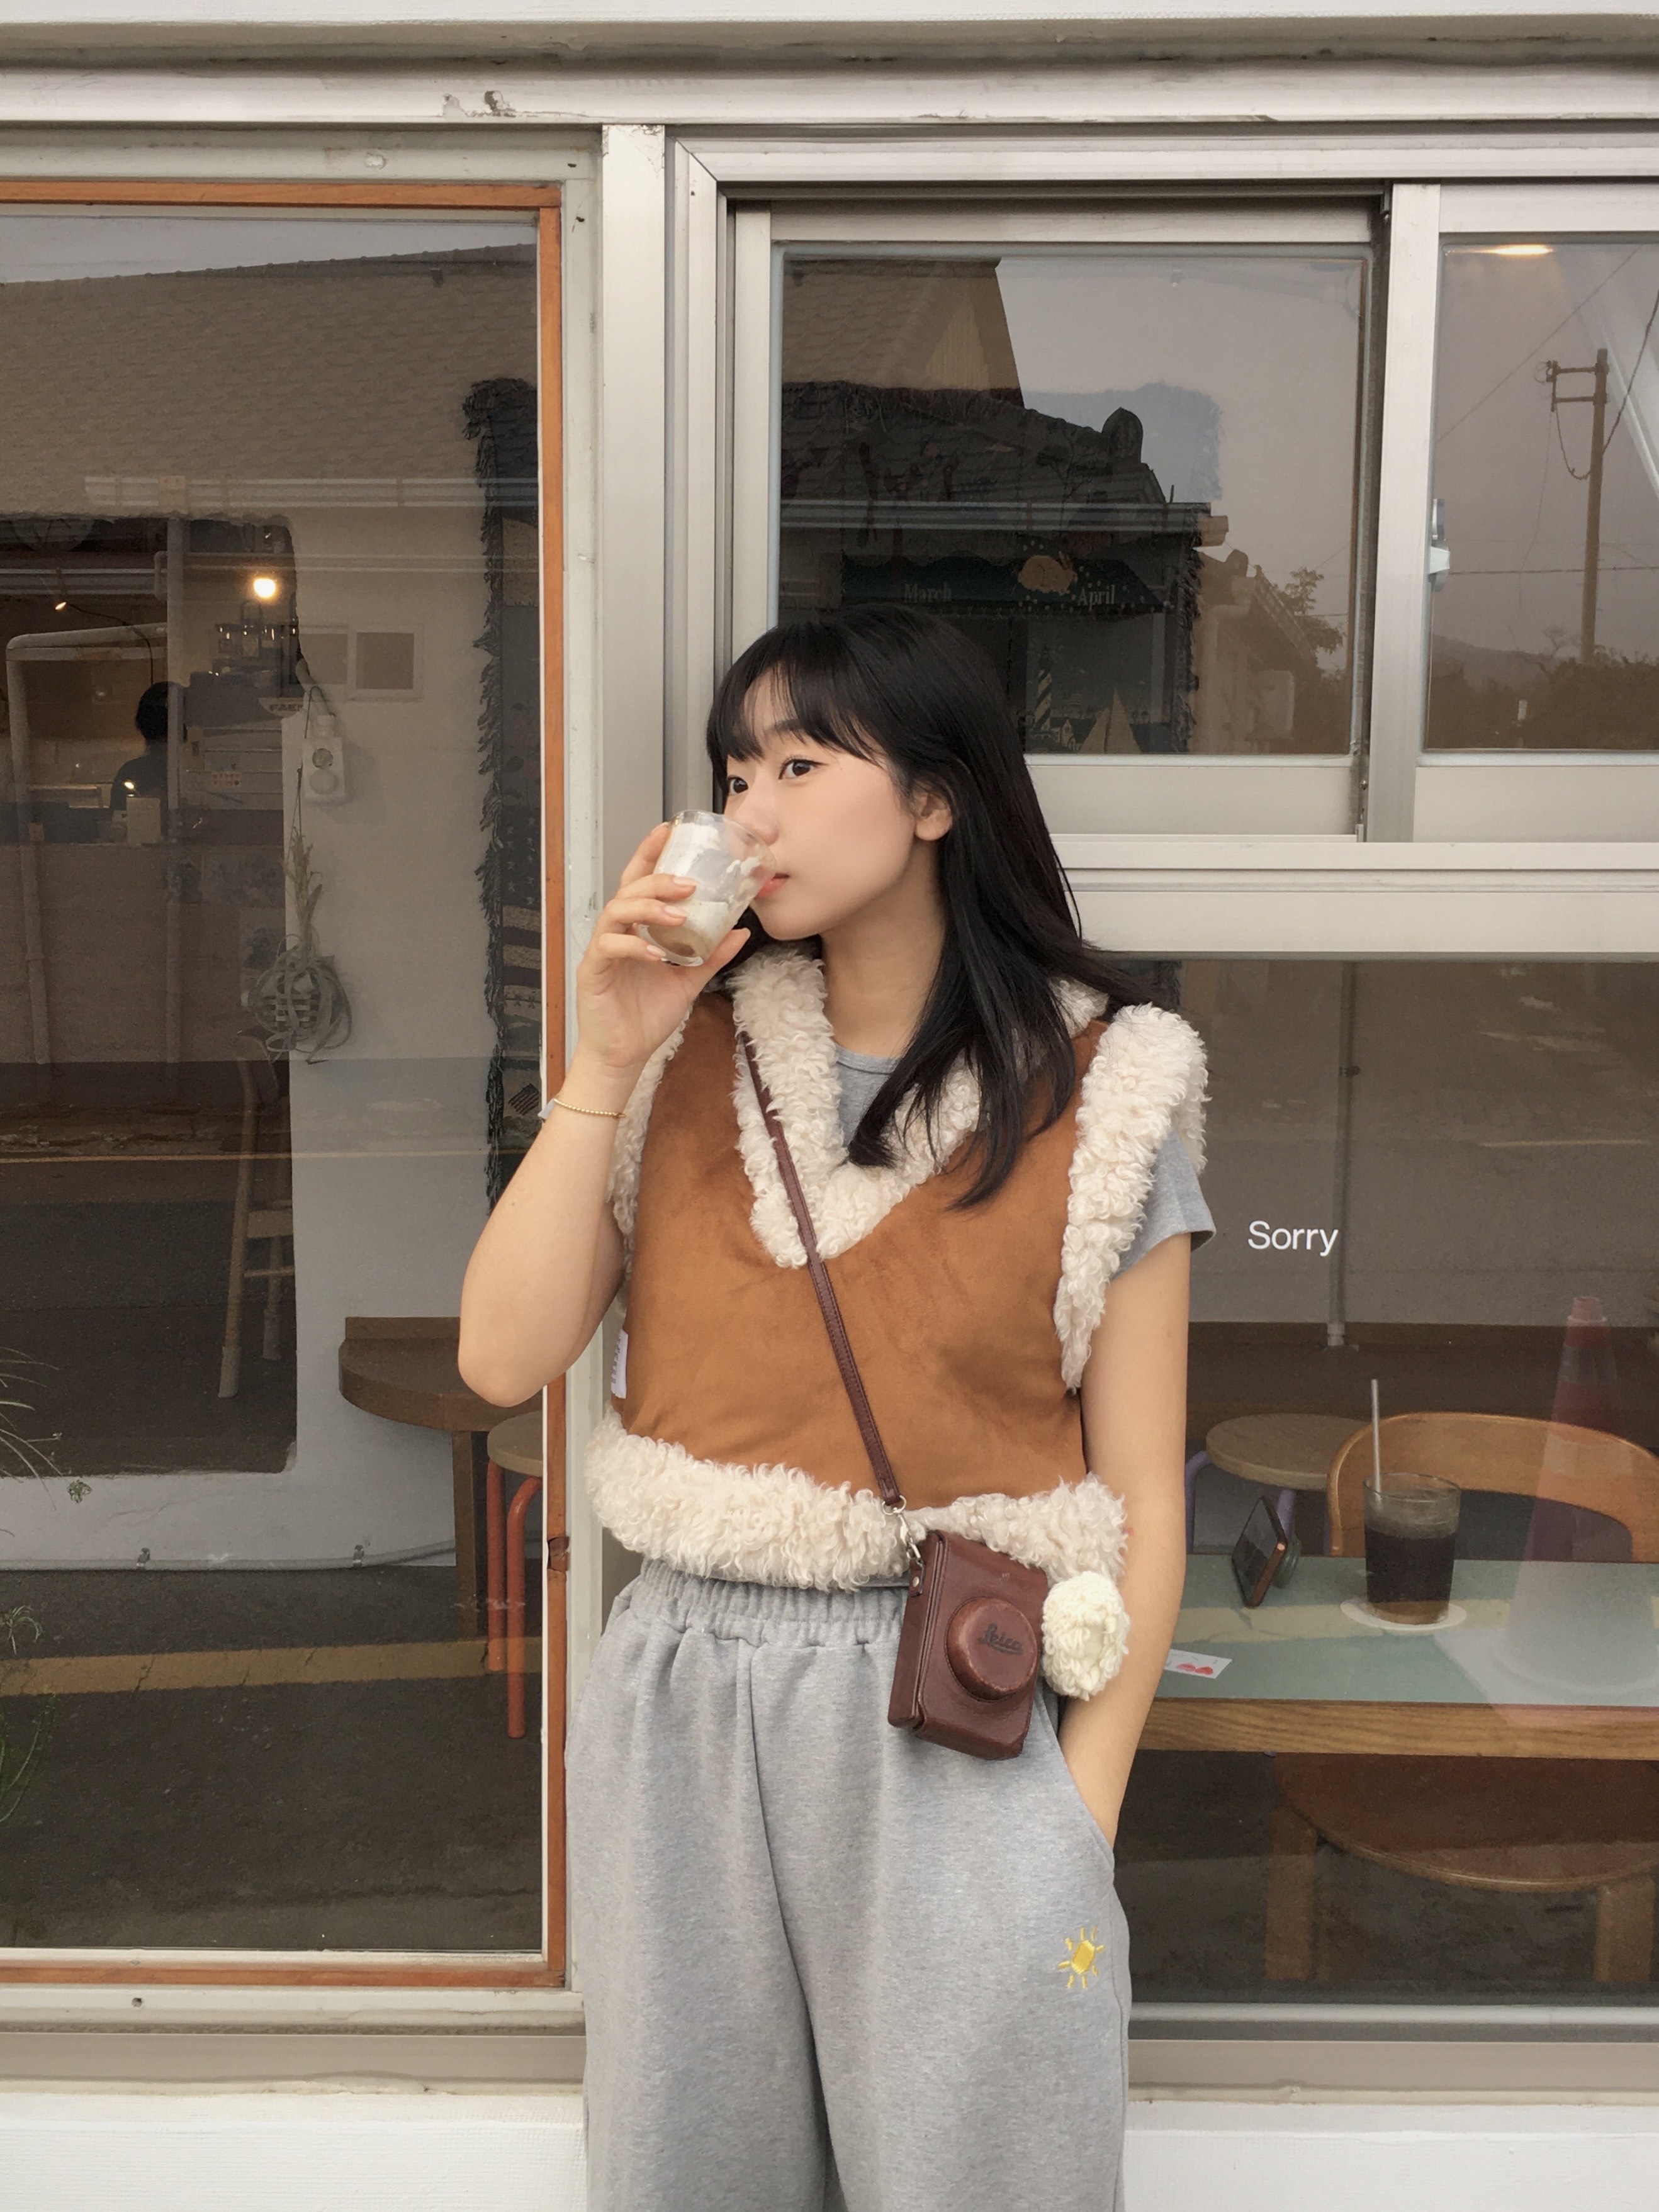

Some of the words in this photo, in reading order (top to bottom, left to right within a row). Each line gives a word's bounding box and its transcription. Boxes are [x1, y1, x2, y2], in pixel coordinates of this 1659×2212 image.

[904, 581, 952, 603] March
[1077, 584, 1115, 612] April
[1247, 1220, 1339, 1257] Sorry
[977, 1622, 1024, 1656] Leica
